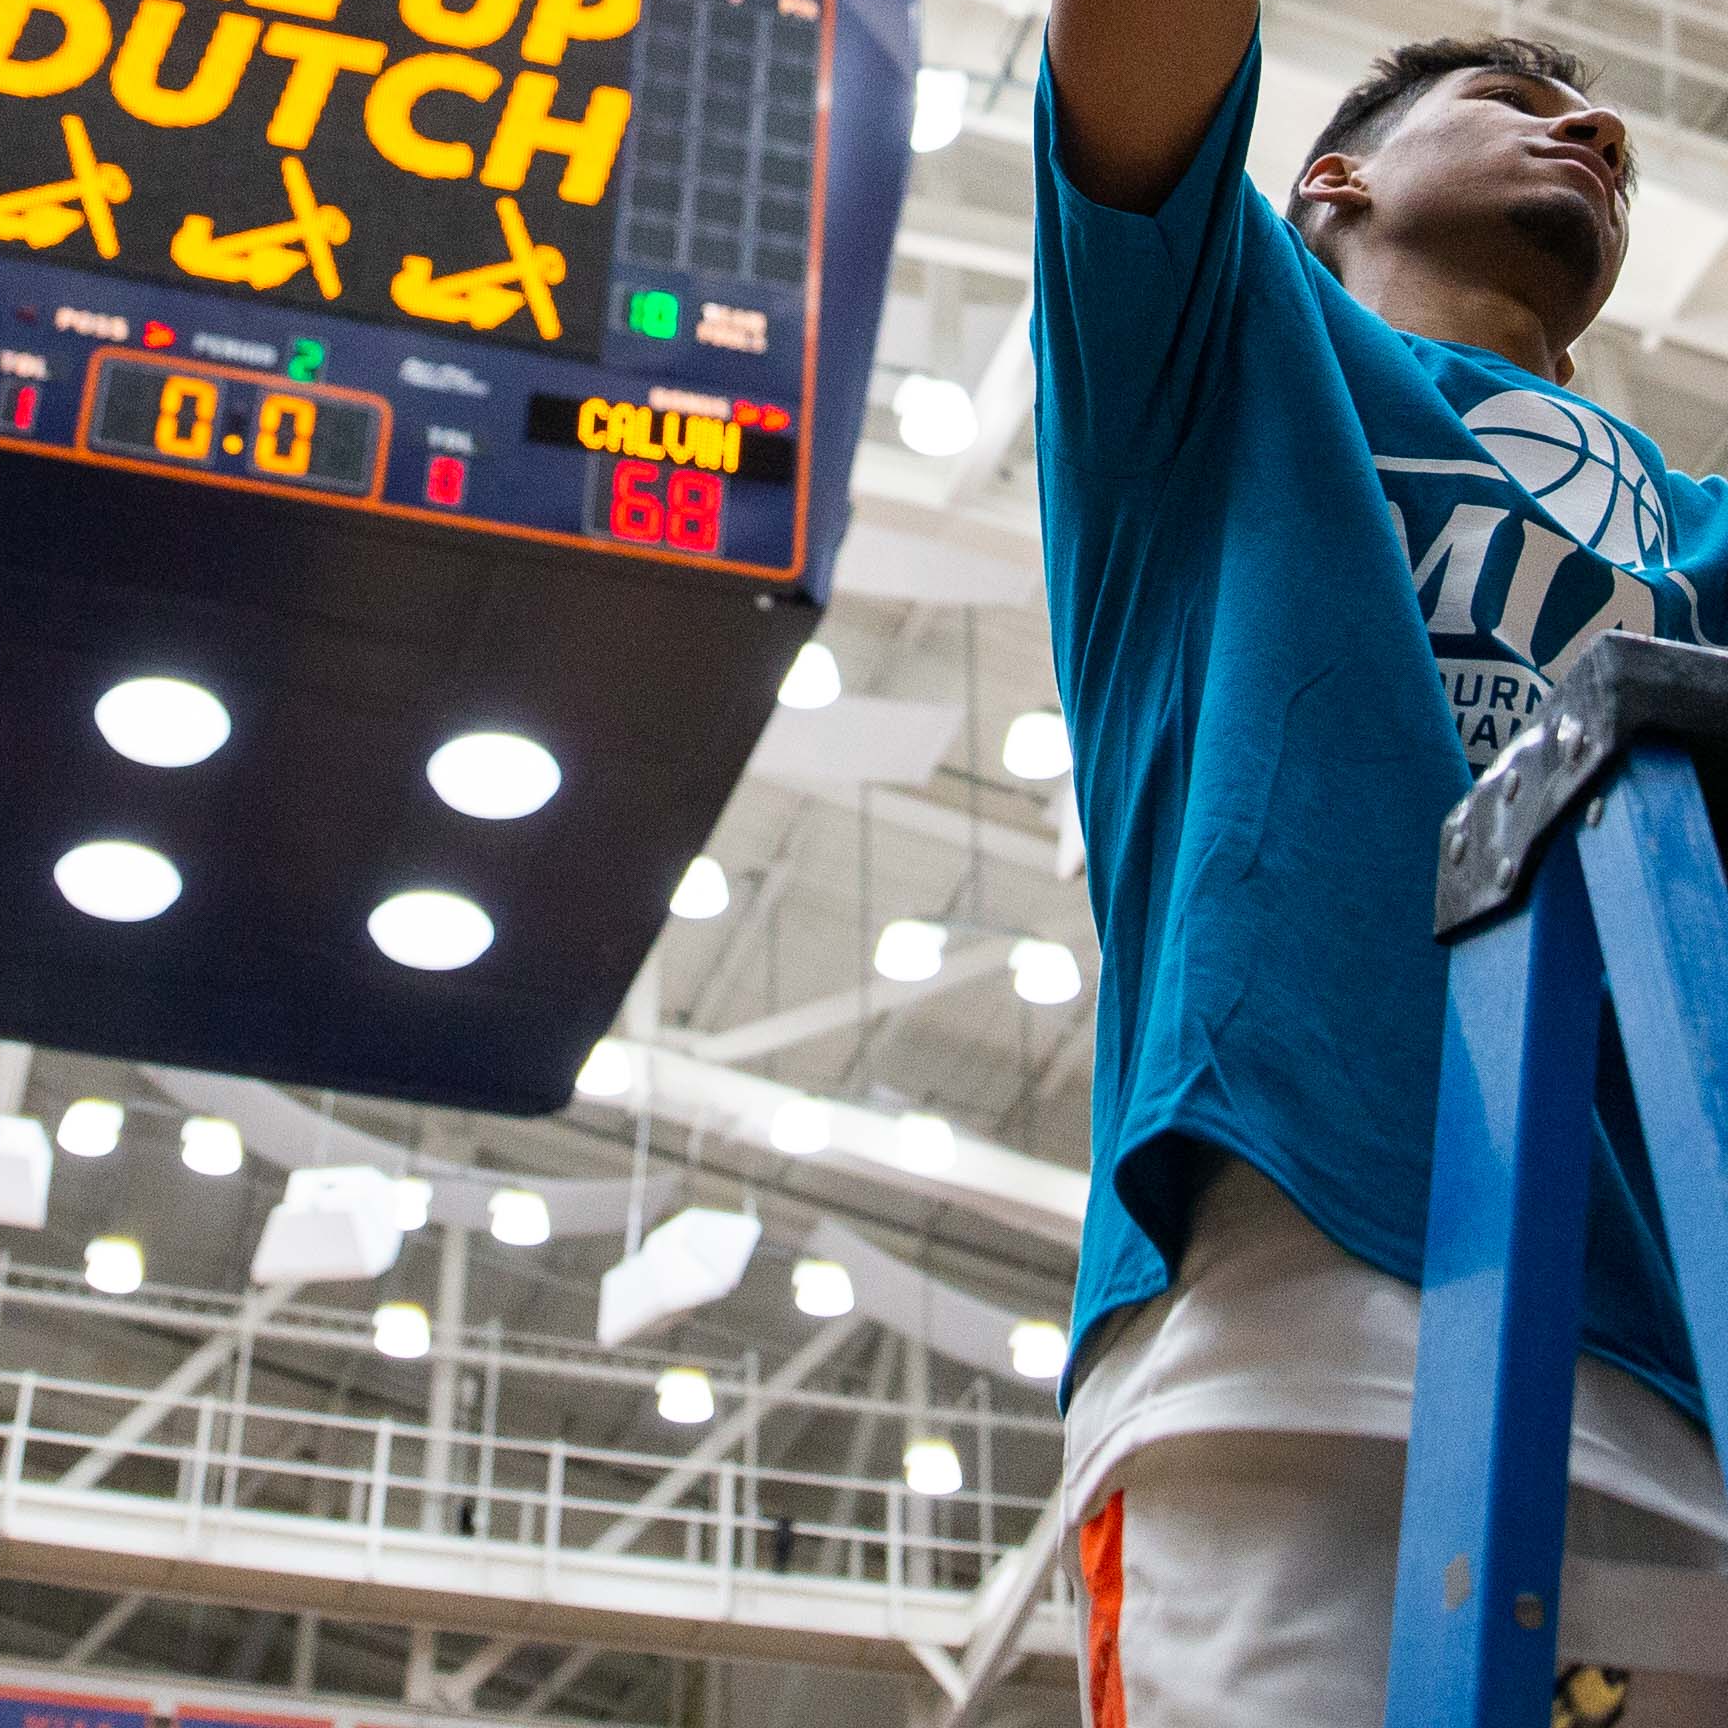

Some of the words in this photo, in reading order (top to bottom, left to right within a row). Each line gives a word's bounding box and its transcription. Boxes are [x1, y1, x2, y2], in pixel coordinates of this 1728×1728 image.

[287, 338, 326, 383] 2
[577, 396, 742, 474] CALVIN
[609, 458, 724, 554] 68
